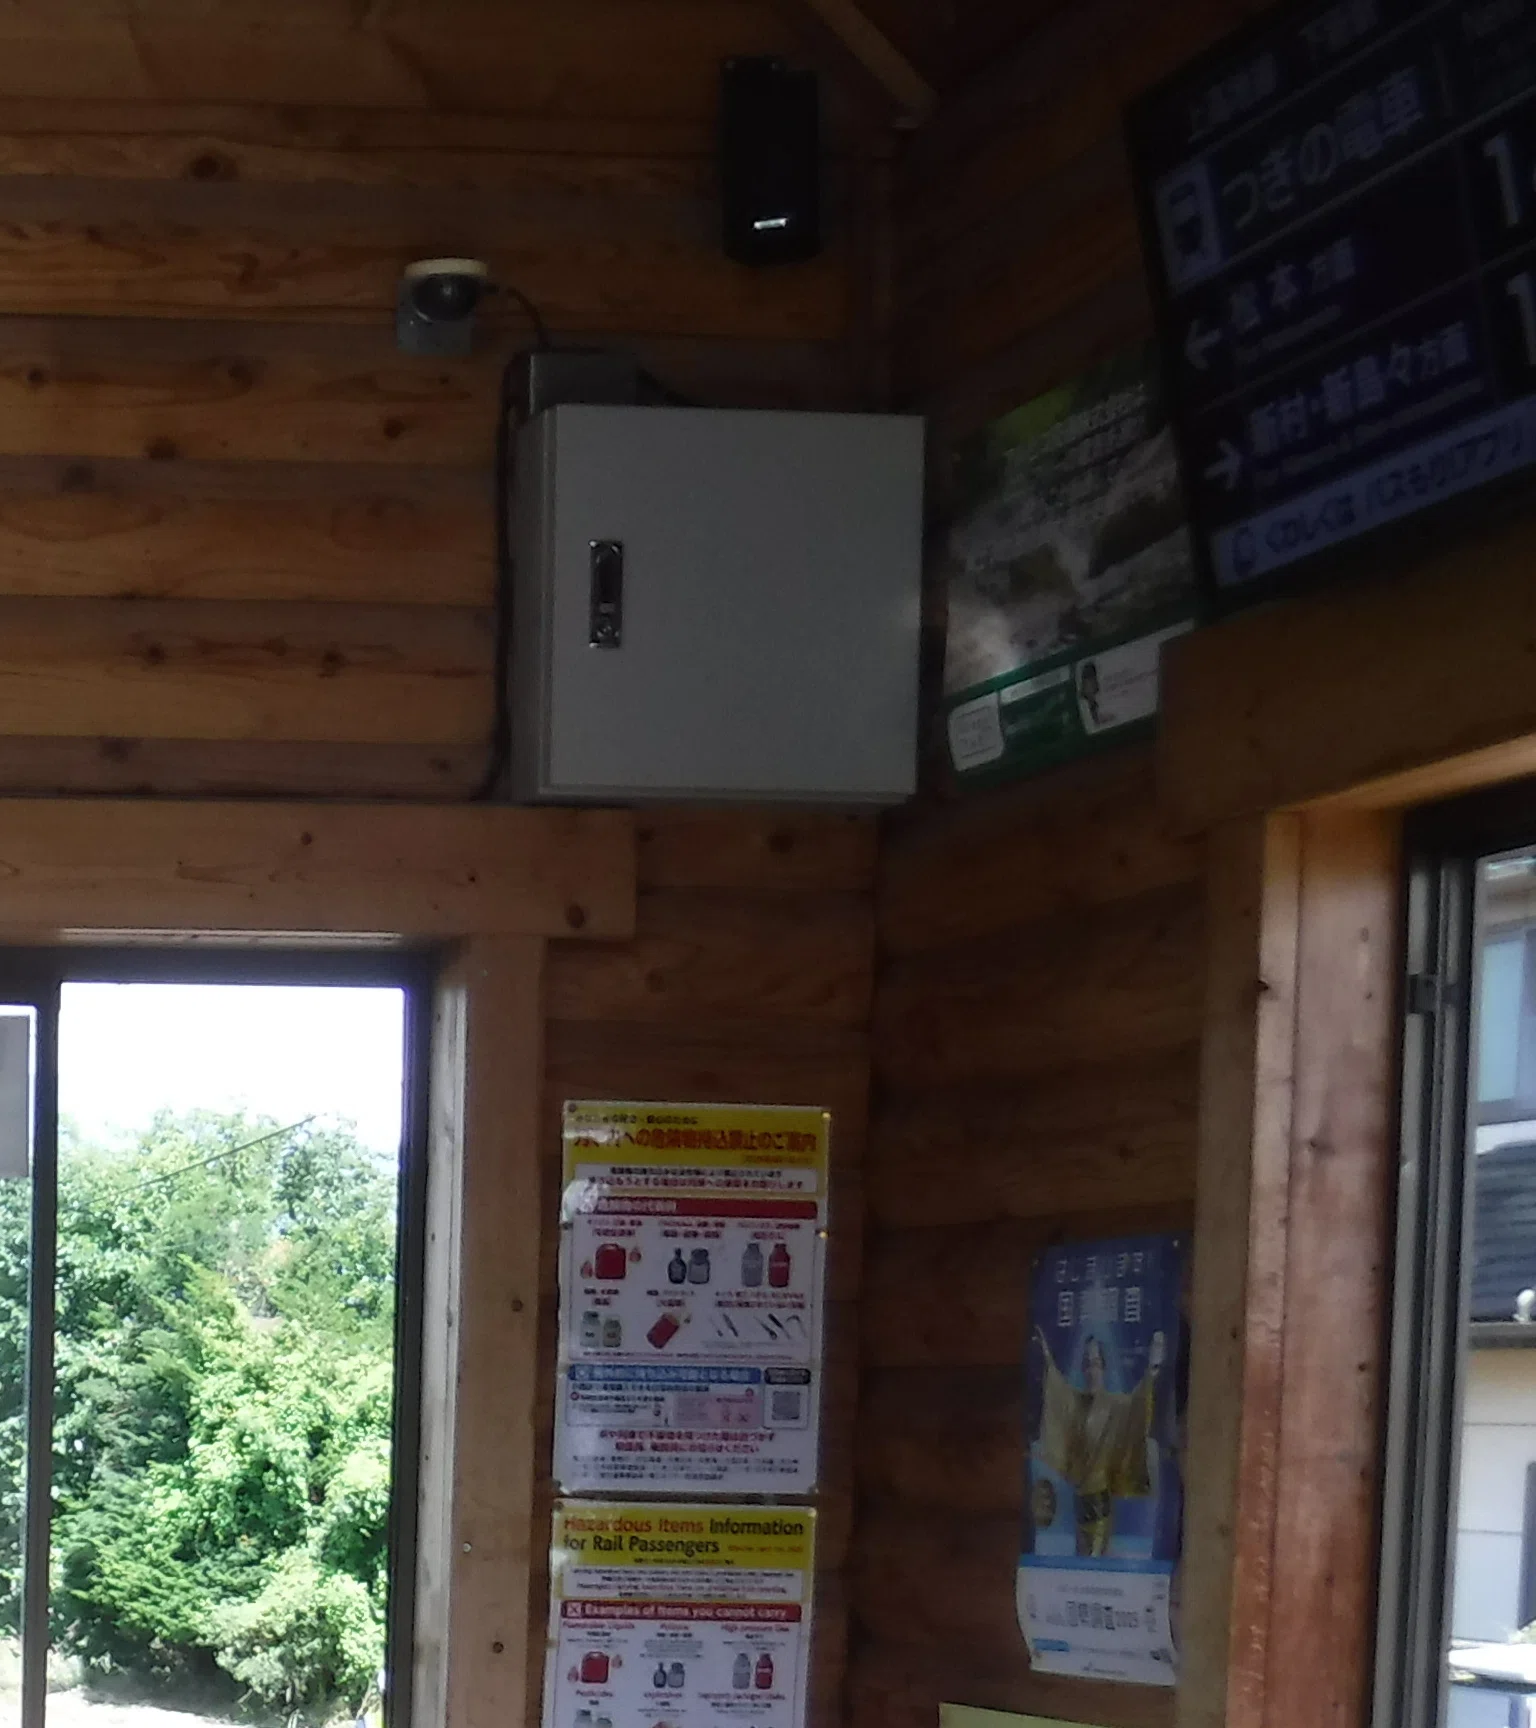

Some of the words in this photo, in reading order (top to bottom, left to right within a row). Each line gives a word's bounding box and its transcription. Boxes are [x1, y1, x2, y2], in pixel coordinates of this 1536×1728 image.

[1221, 66, 1426, 231] つぎの電車
[563, 1516, 653, 1534] Hazardous
[658, 1517, 705, 1534] Items
[709, 1516, 804, 1536] Information
[562, 1534, 588, 1552] for
[592, 1535, 625, 1553] Rail
[628, 1536, 720, 1557] Passengers
[584, 1603, 634, 1618] Examples
[636, 1604, 652, 1616] of
[691, 1607, 713, 1620] you
[716, 1607, 755, 1619] cannot
[757, 1608, 787, 1621] carry
